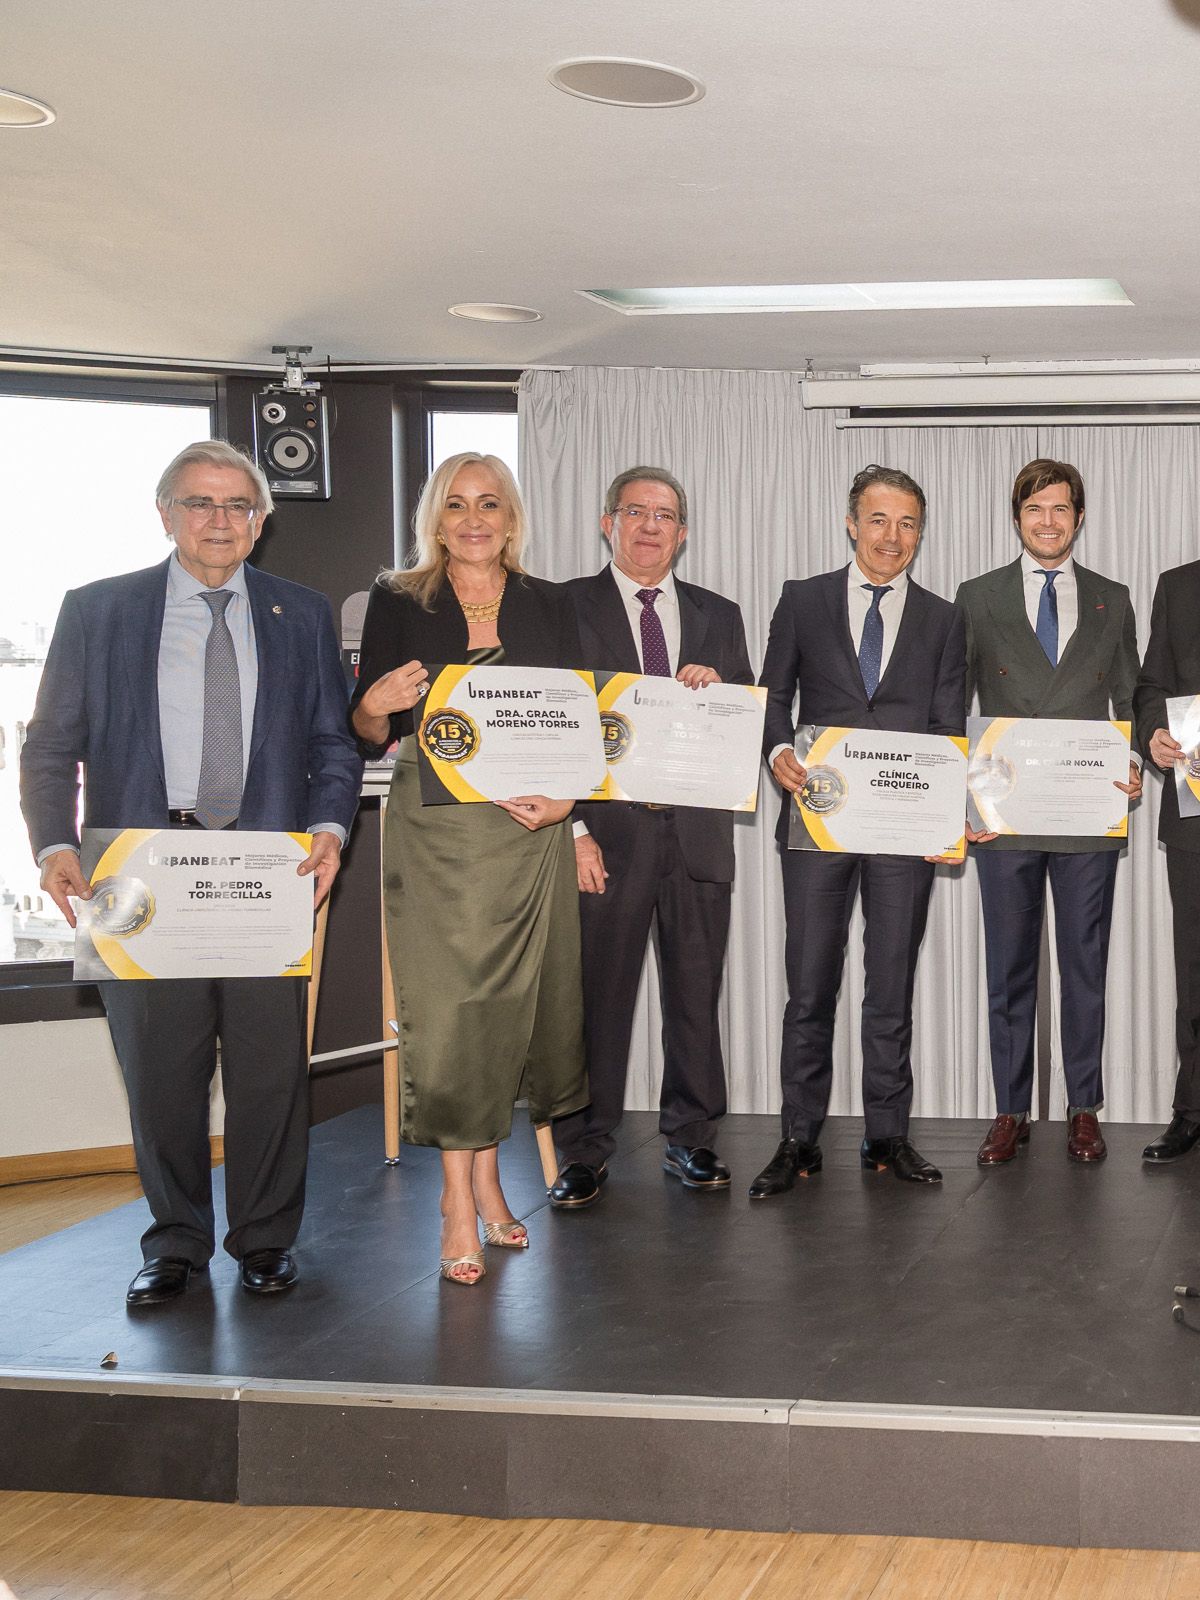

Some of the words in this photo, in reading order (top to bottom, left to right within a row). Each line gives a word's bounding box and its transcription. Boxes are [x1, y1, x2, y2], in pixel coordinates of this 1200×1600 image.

[468, 682, 542, 700] URBANBEAT
[496, 710, 524, 718] DRA.
[527, 710, 567, 719] GRACIA
[487, 720, 536, 728] MORENO
[539, 720, 580, 729] TORRES
[437, 724, 461, 739] 15
[844, 743, 912, 762] URBANBEAT
[879, 770, 920, 780] CLÍNICA
[812, 780, 831, 793] 15
[870, 779, 930, 790] CERQUEIRO
[148, 847, 241, 867] URBANBEAT
[195, 881, 217, 889] DR.
[221, 881, 263, 889] PEDRO
[188, 891, 272, 899] TORRECILLAS
